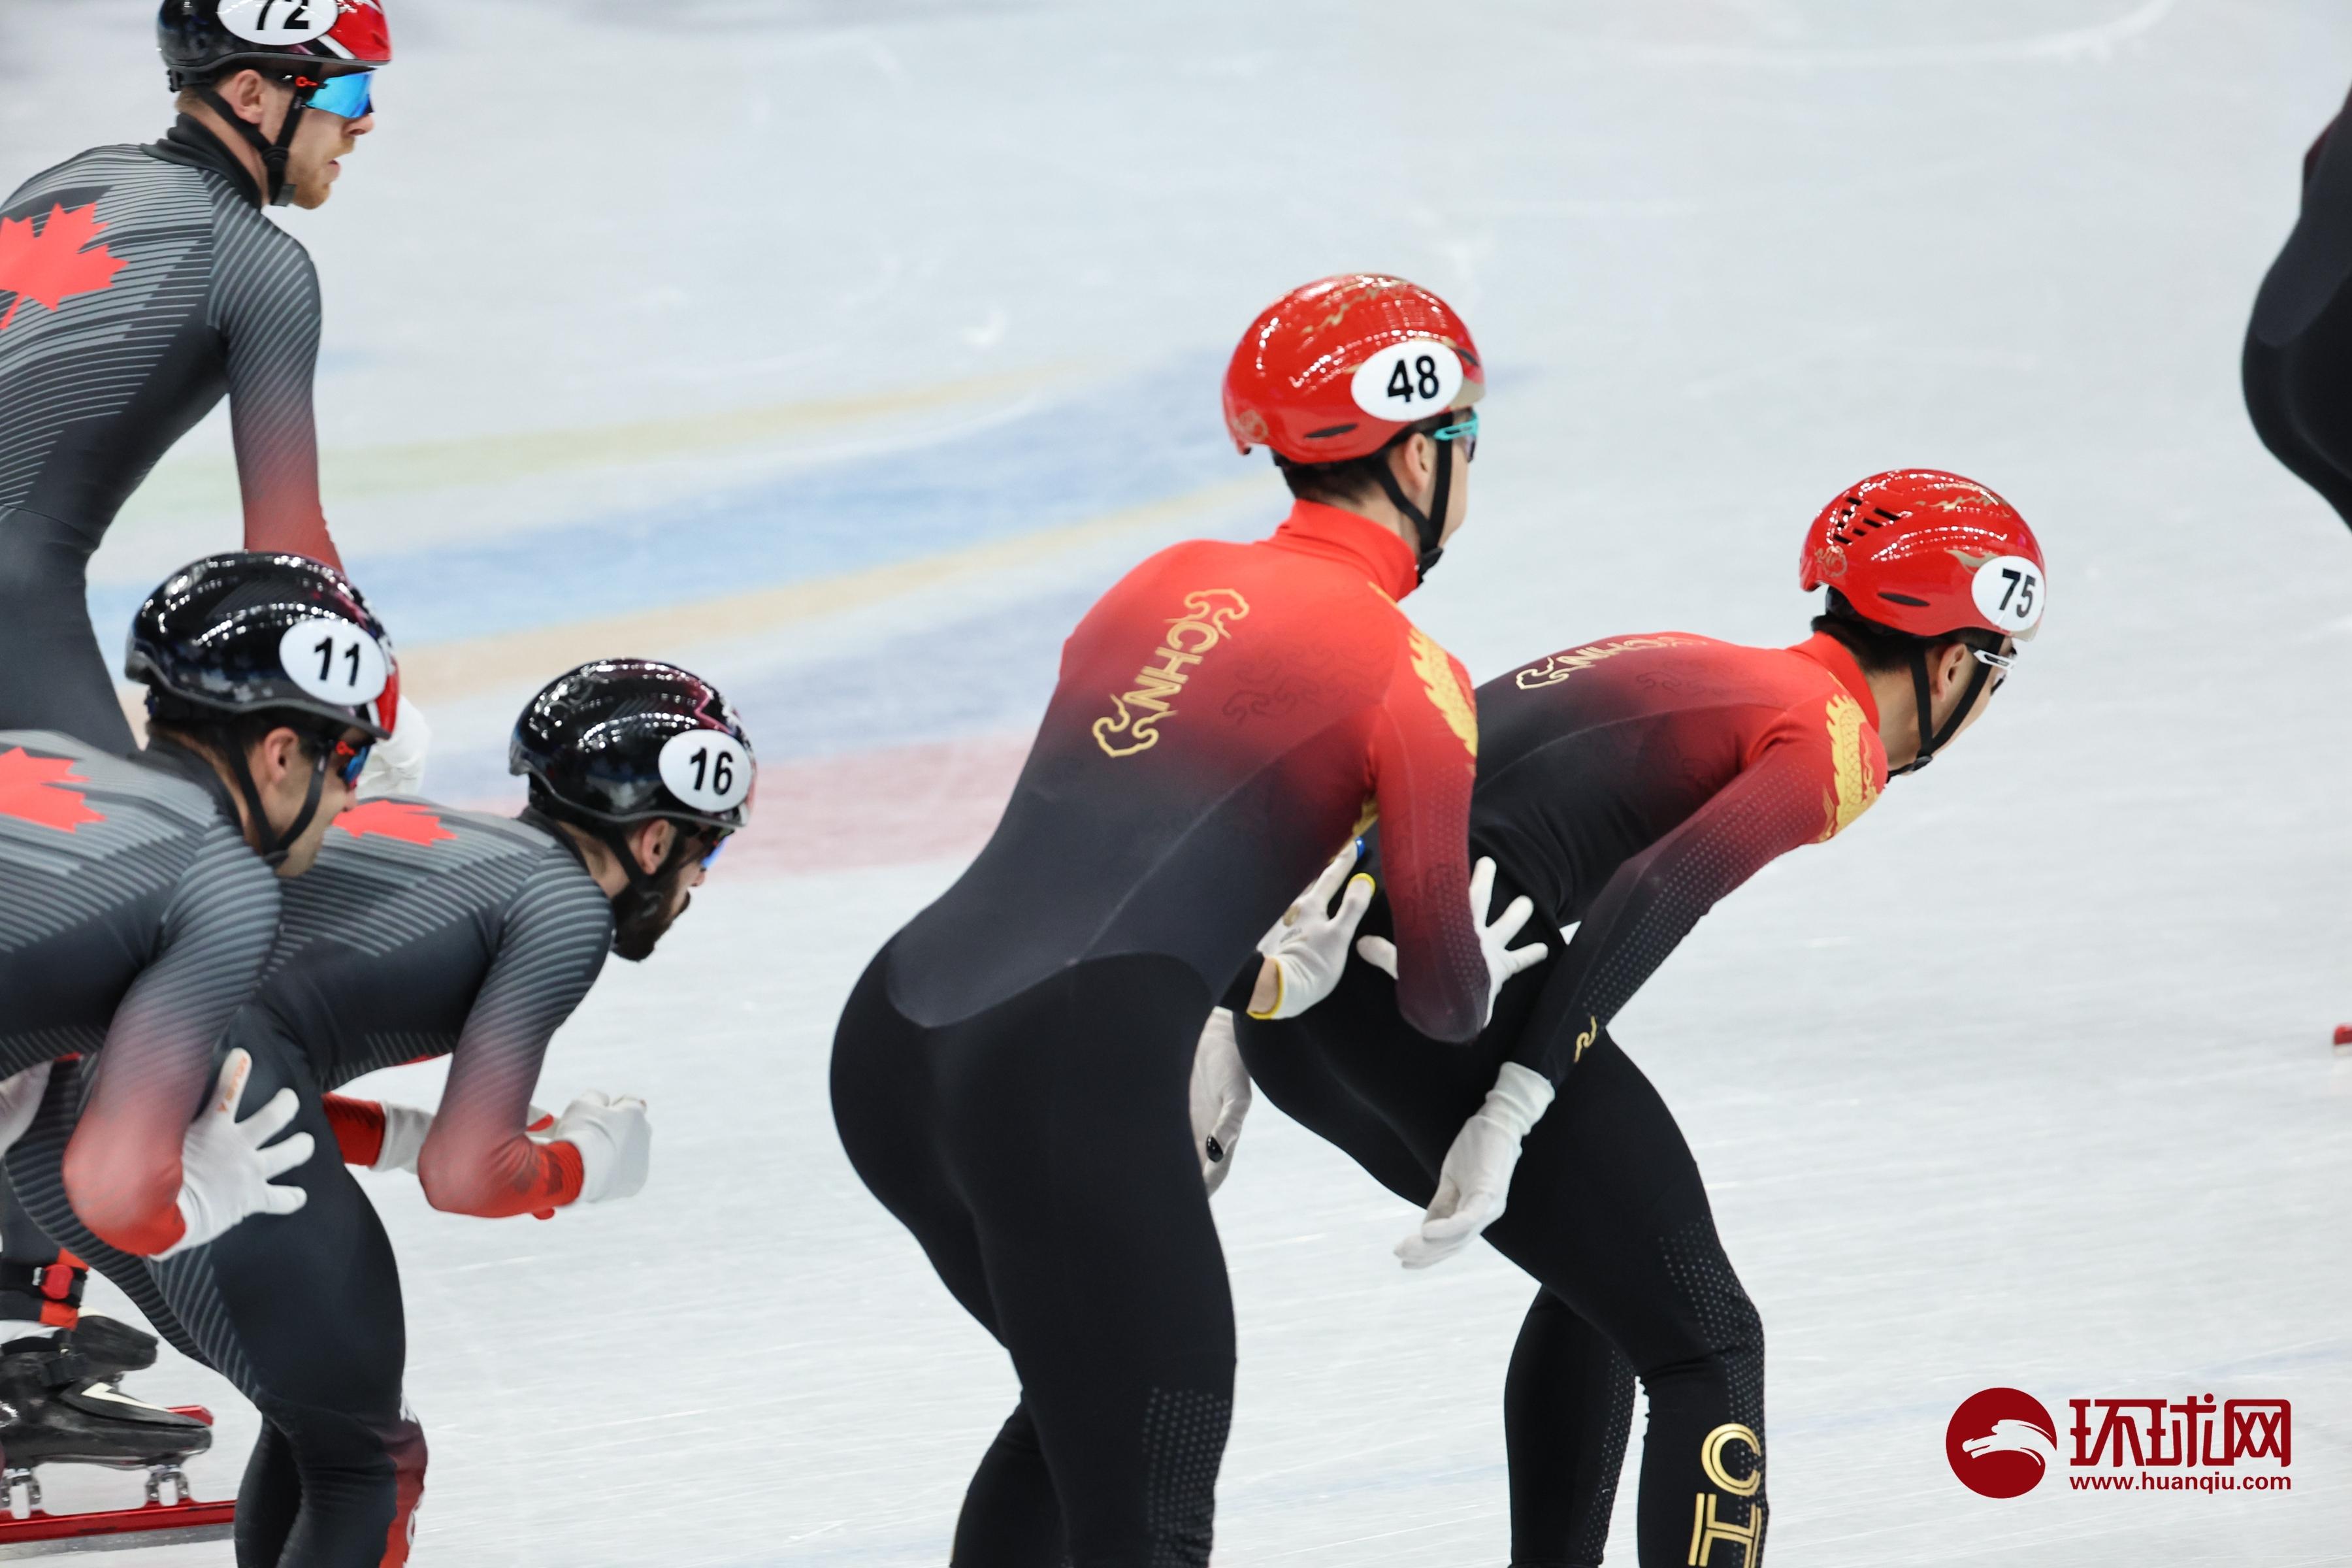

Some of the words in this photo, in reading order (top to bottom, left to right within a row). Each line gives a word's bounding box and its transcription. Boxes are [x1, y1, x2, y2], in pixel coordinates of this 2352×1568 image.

[1388, 355, 1439, 402] 48
[1999, 568, 2036, 617] 75
[314, 637, 360, 686] 11
[690, 747, 733, 795] 16
